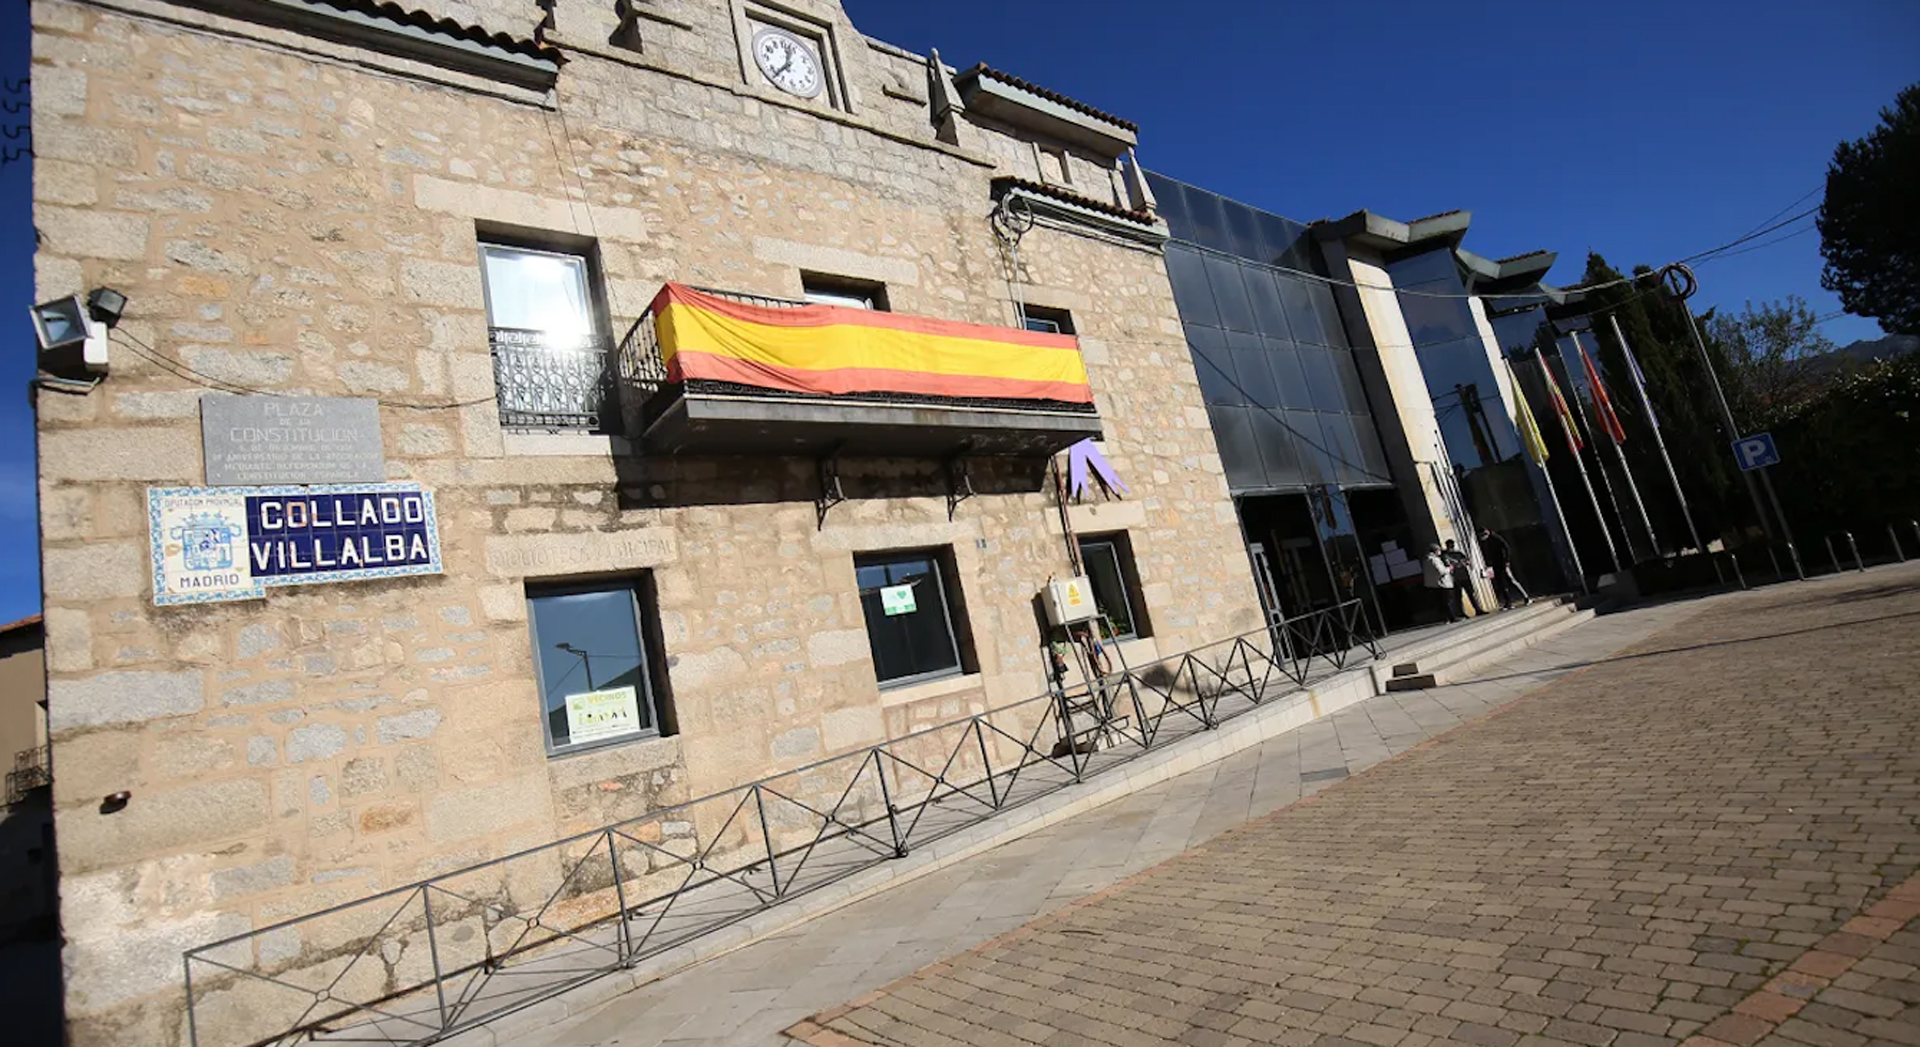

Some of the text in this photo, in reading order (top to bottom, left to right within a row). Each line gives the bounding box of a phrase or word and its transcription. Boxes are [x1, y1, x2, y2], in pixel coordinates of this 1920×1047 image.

[264, 402, 324, 417] PLAZA
[1740, 440, 1766, 466] P
[261, 497, 424, 530] COLLADO
[251, 533, 428, 571] VILLALBA
[180, 574, 239, 588] MADRID
